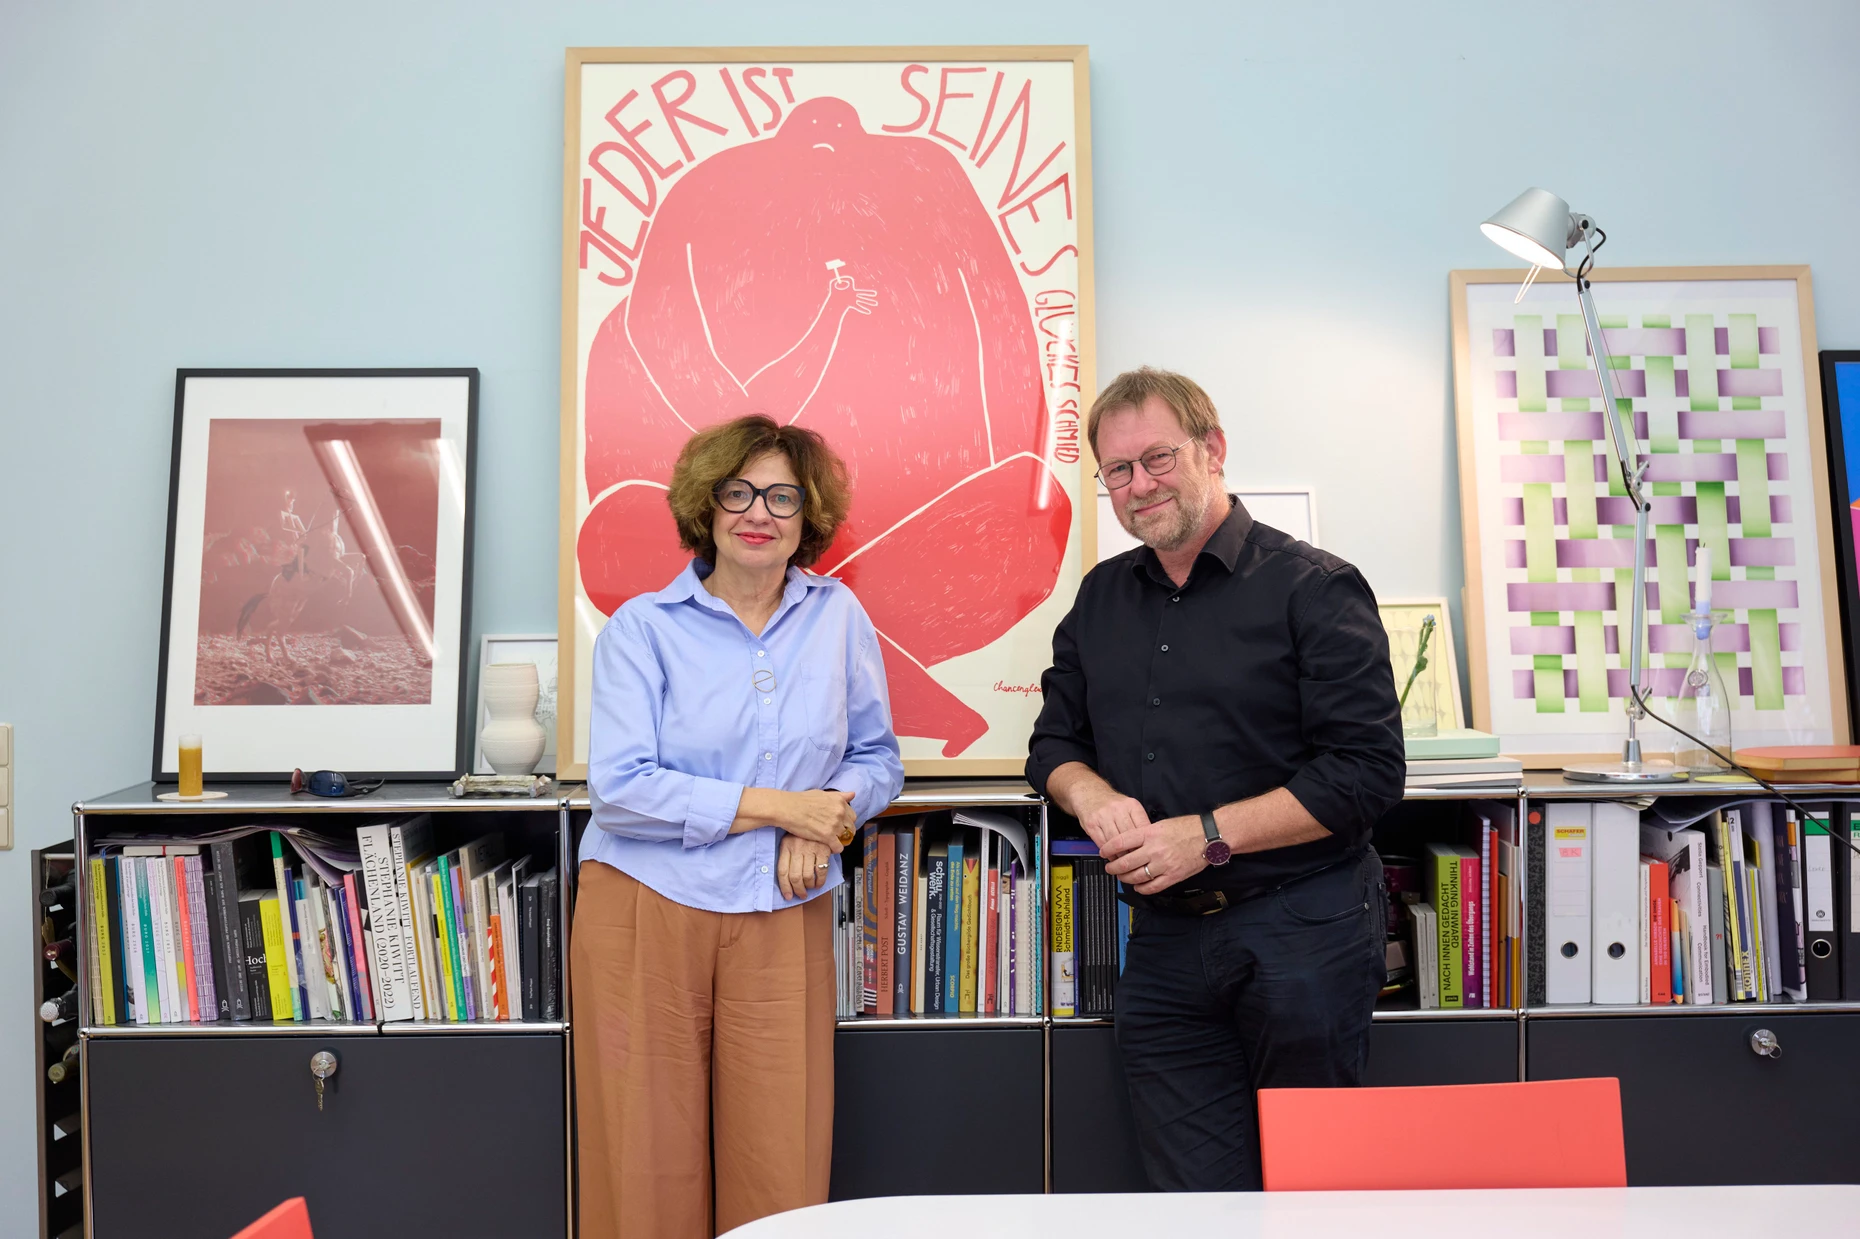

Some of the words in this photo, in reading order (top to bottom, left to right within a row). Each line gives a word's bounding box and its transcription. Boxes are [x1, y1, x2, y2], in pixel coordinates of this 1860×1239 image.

[580, 69, 729, 287] JEDER
[719, 67, 795, 138] IST
[881, 64, 1078, 276] SEINES
[392, 833, 406, 889] STEPHANIE
[898, 853, 909, 905] WEIDANZ
[362, 835, 385, 934] FLÄCHENLAND
[1441, 882, 1450, 928] GEDACHT
[1450, 861, 1458, 908] THINKING
[378, 857, 398, 931] STEPHANIE
[388, 934, 405, 984] KIWITT
[400, 892, 411, 930] KIWITT
[897, 912, 907, 955] GUSTAV
[1450, 910, 1459, 948] INWARD
[880, 936, 888, 957] POST
[405, 936, 421, 1010] FORTLAUFEND
[880, 958, 888, 993] HERBERT
[1443, 963, 1451, 991] NACH
